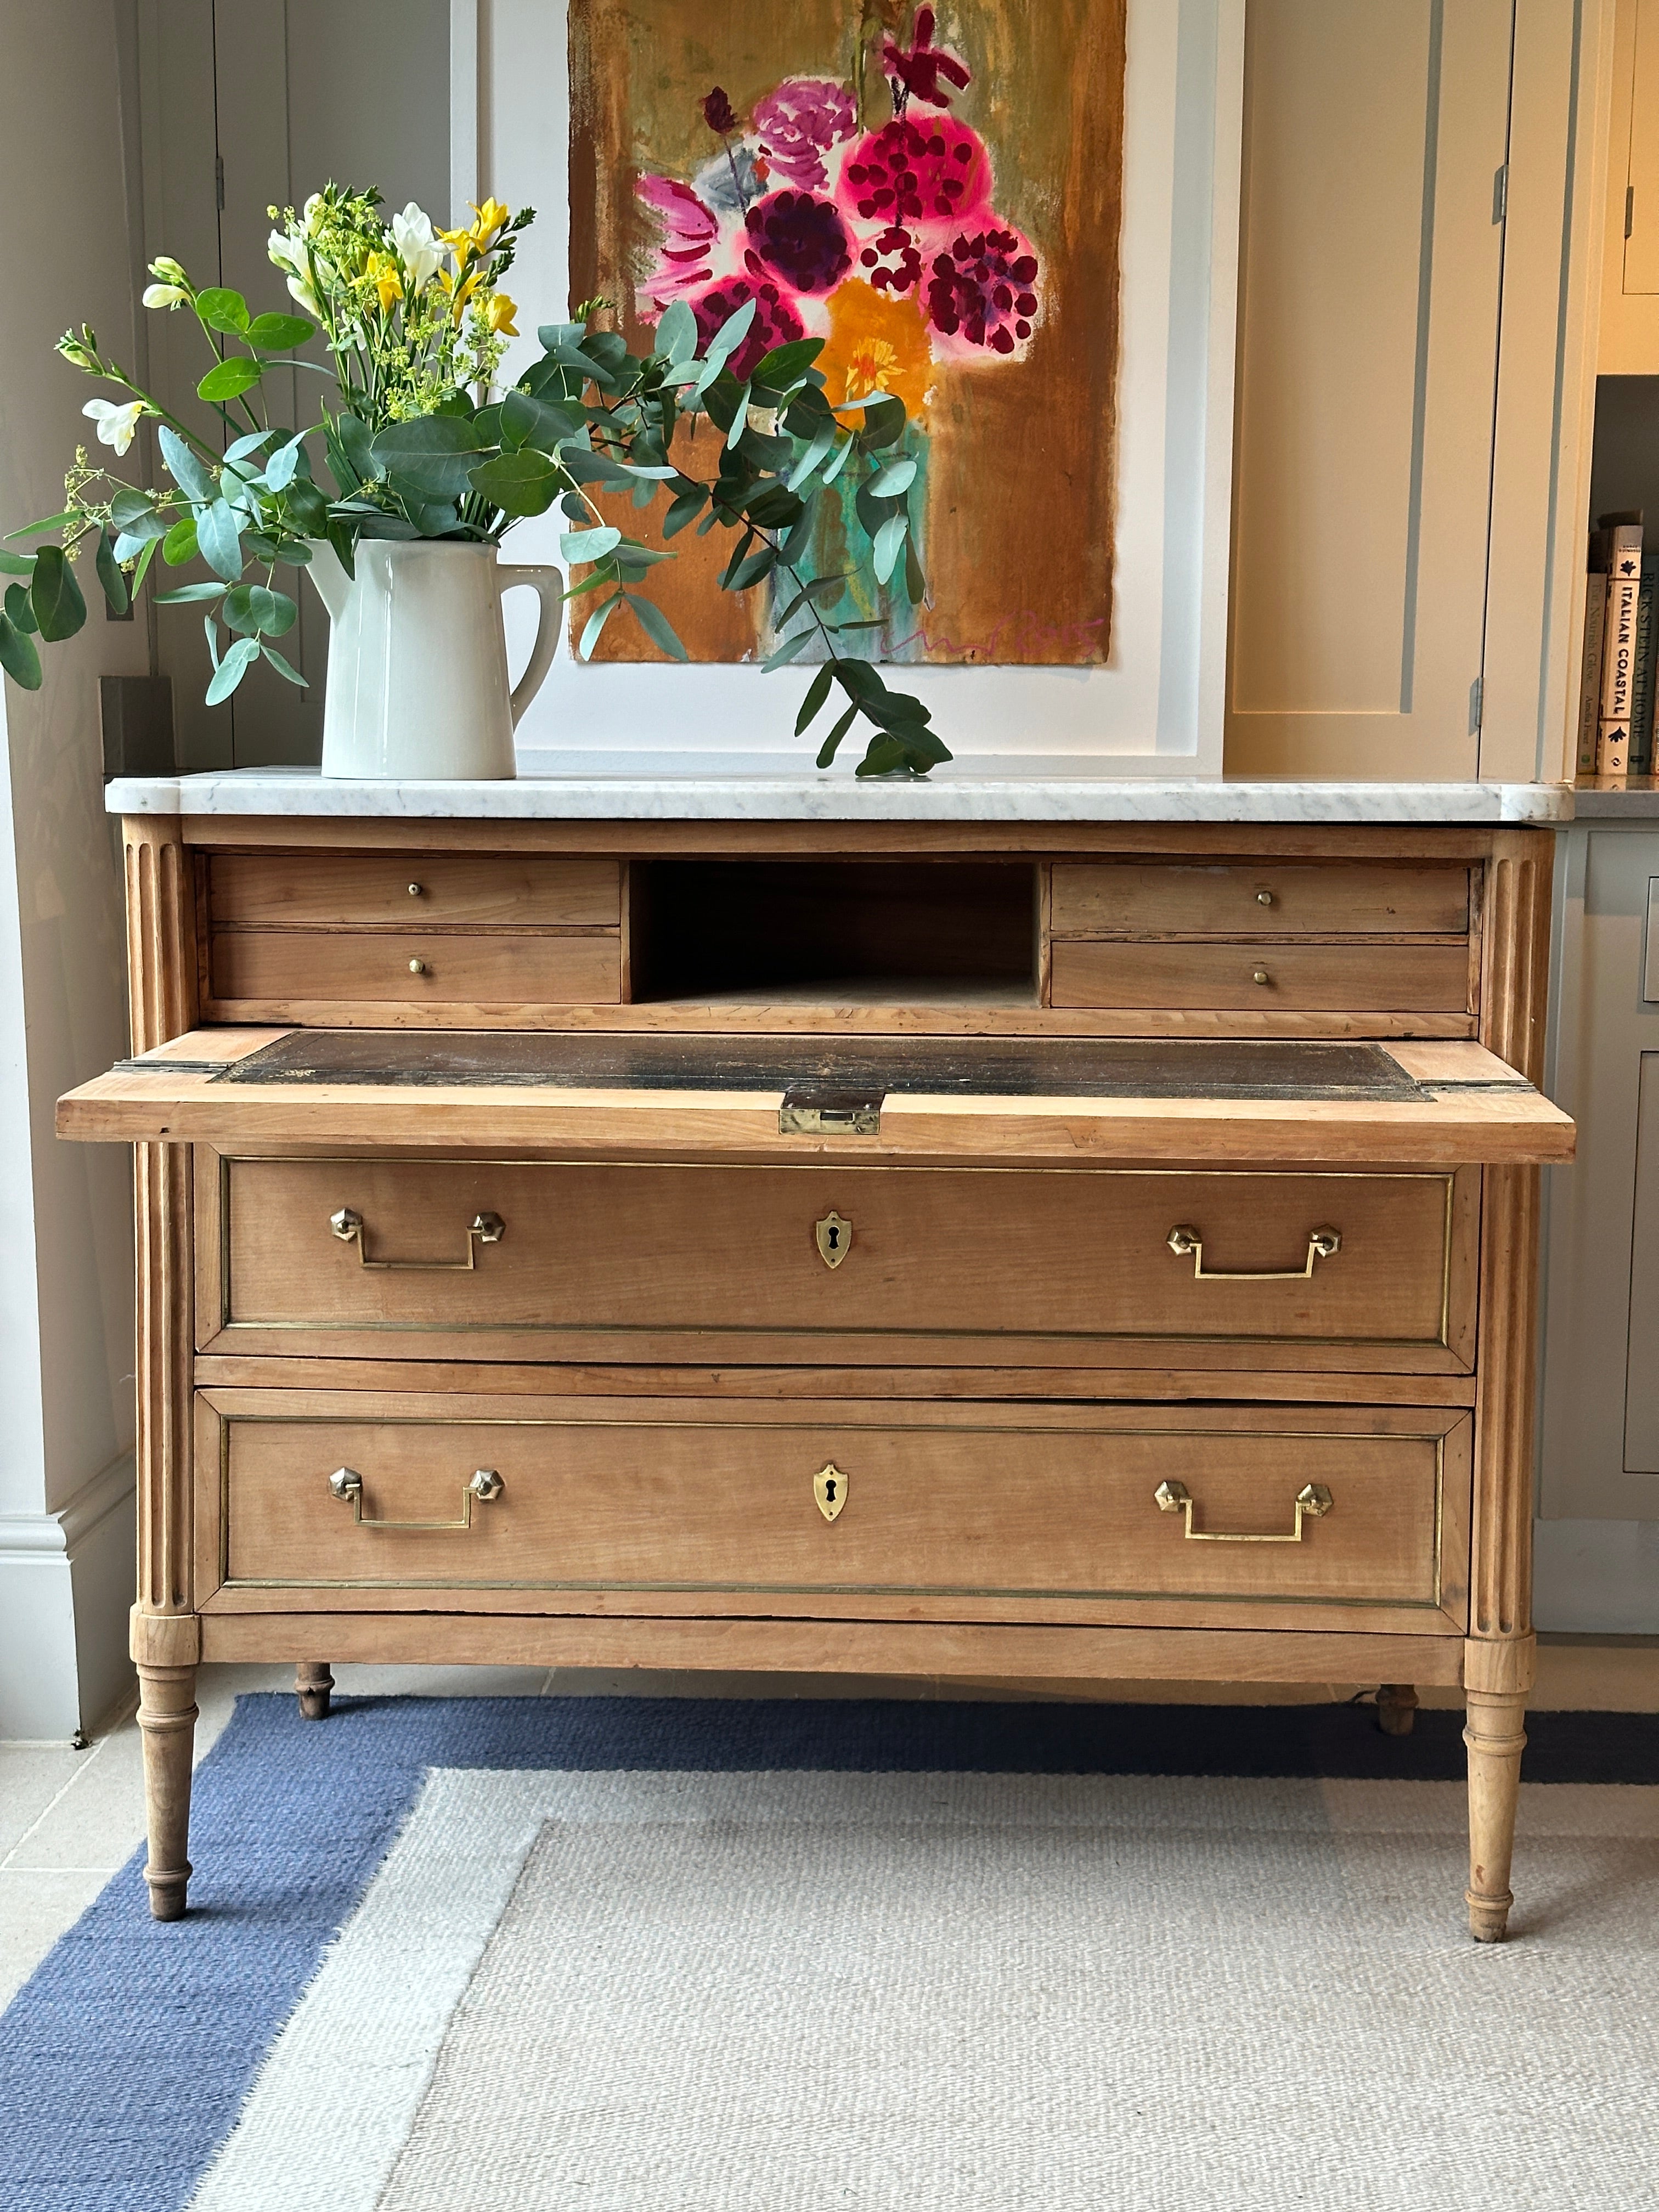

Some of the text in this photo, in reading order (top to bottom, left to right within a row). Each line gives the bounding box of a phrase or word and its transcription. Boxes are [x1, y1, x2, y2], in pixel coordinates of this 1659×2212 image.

[1641, 573, 1655, 611] RICK
[1613, 586, 1633, 714] ITALIAN COASTAL
[1638, 615, 1651, 662] STEIN
[1633, 692, 1646, 738] HOME
